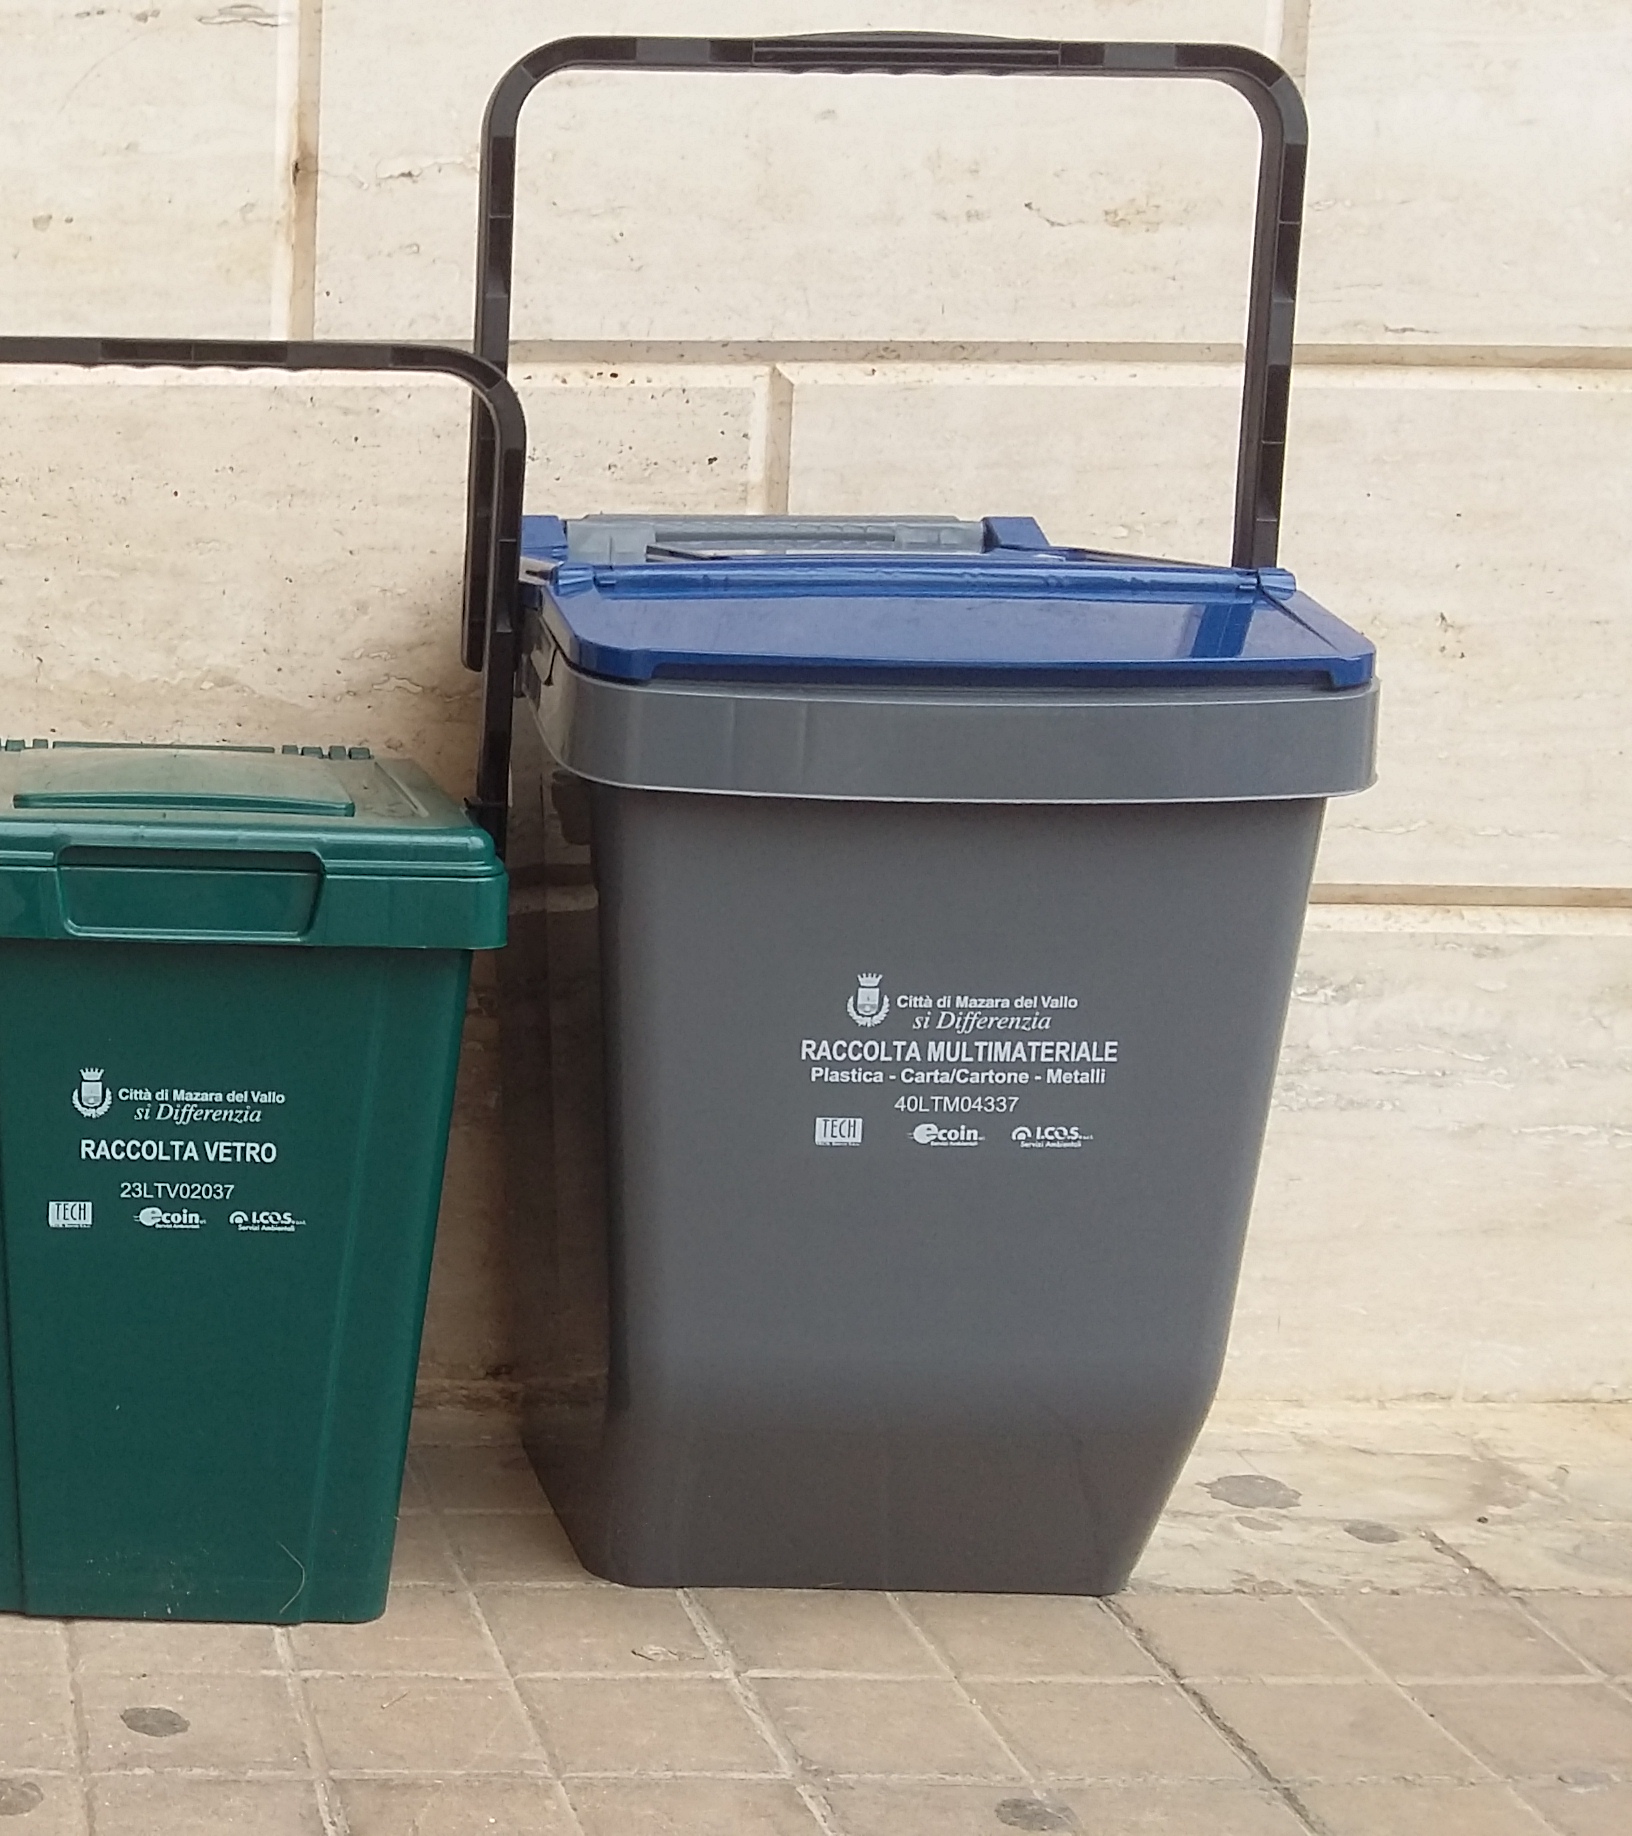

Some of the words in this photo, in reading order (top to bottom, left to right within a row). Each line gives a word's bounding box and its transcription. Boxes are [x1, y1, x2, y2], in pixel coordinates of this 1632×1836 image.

[896, 994, 933, 1009] Città
[936, 995, 952, 1009] di
[955, 995, 1011, 1009] Mazara
[1013, 995, 1038, 1009] del
[1040, 995, 1078, 1009] Vallo
[912, 1011, 932, 1030] si
[935, 1010, 1052, 1035] Differenzia
[801, 1039, 922, 1062] RACCOLTA
[927, 1040, 1119, 1063] MULTIMATERIALE
[811, 1066, 884, 1083] Plastica
[900, 1067, 1030, 1084] Carta/Cartone
[1046, 1068, 1106, 1084] Metalli
[118, 1087, 152, 1101] Città
[154, 1088, 169, 1101] di
[172, 1088, 223, 1103] Mazara
[226, 1090, 249, 1103] del
[250, 1090, 286, 1104] Vallo
[893, 1095, 1020, 1113] 40LTM04337
[133, 1103, 152, 1121] si
[155, 1102, 263, 1126] Differenzia
[823, 1119, 856, 1138] TECH
[80, 1139, 200, 1162] RACCOLTA
[203, 1141, 277, 1163] VETRO
[120, 1182, 235, 1200] 23LTV02037
[56, 1203, 86, 1220] TECH
